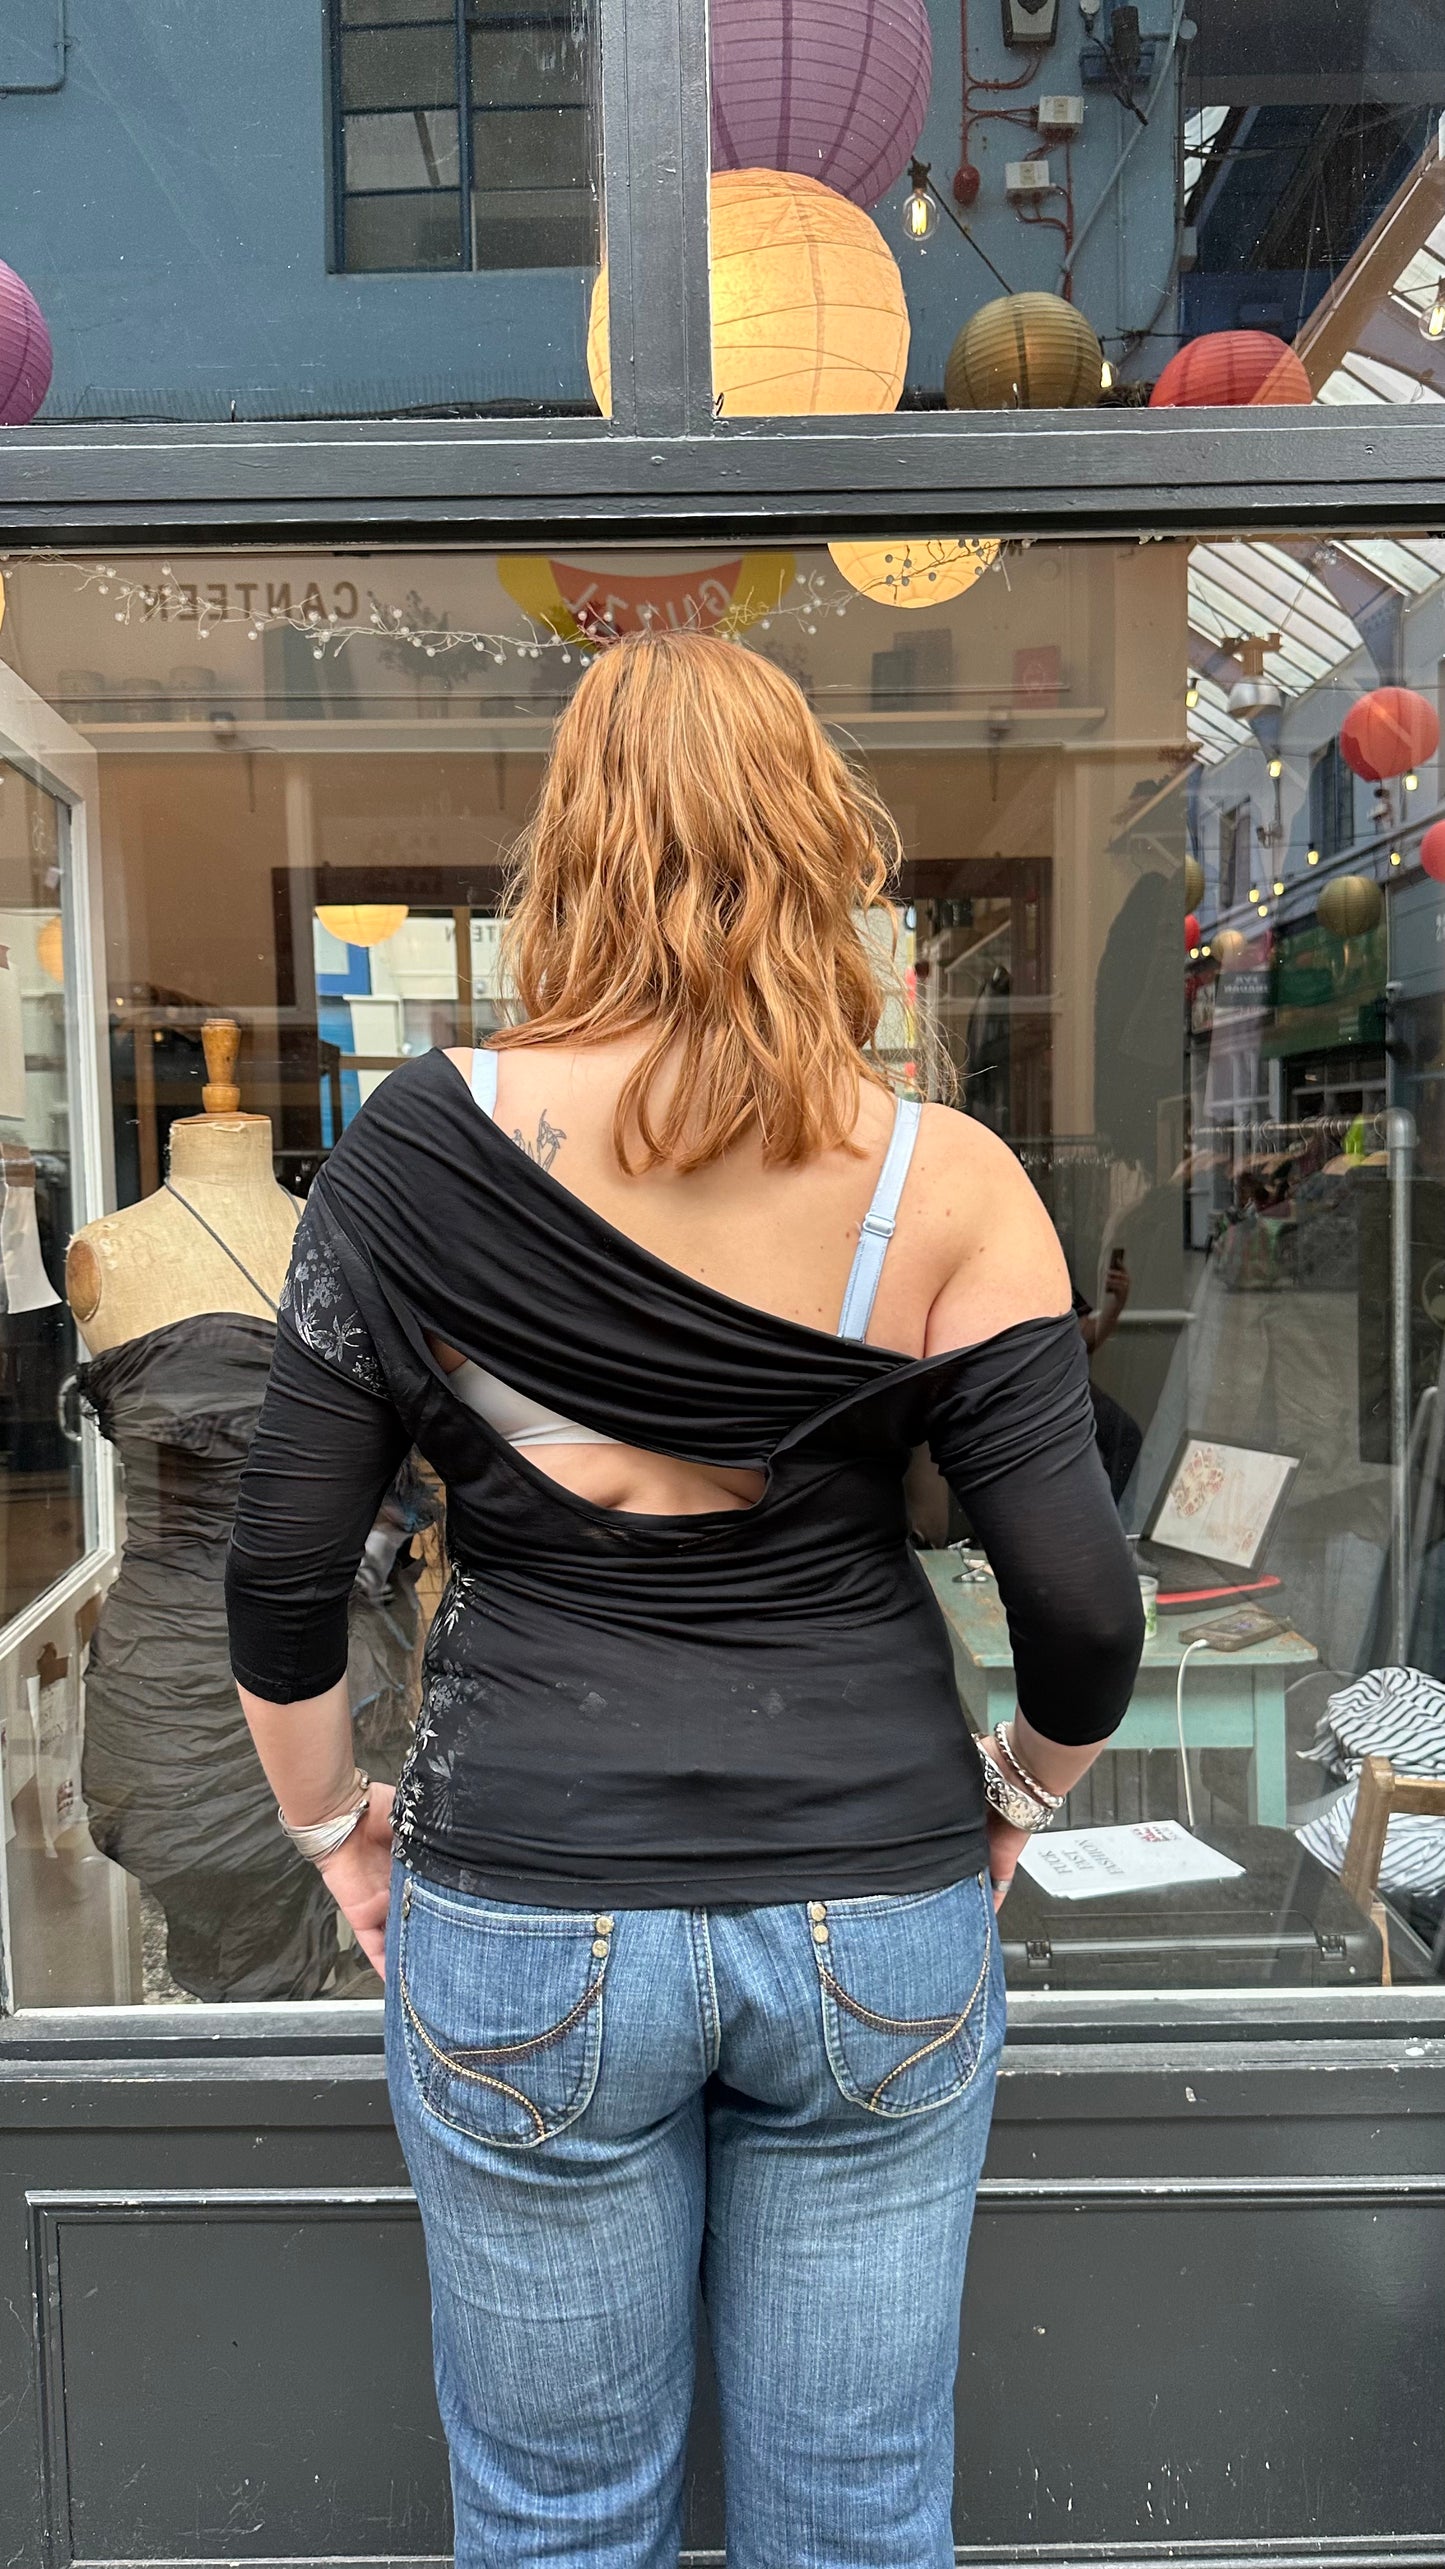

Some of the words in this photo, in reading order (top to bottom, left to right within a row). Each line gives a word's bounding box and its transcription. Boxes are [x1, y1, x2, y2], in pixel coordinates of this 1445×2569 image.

[1038, 1850, 1073, 1874] FUCK
[1061, 1850, 1095, 1870] FAST
[1074, 1839, 1126, 1875] FASHION
